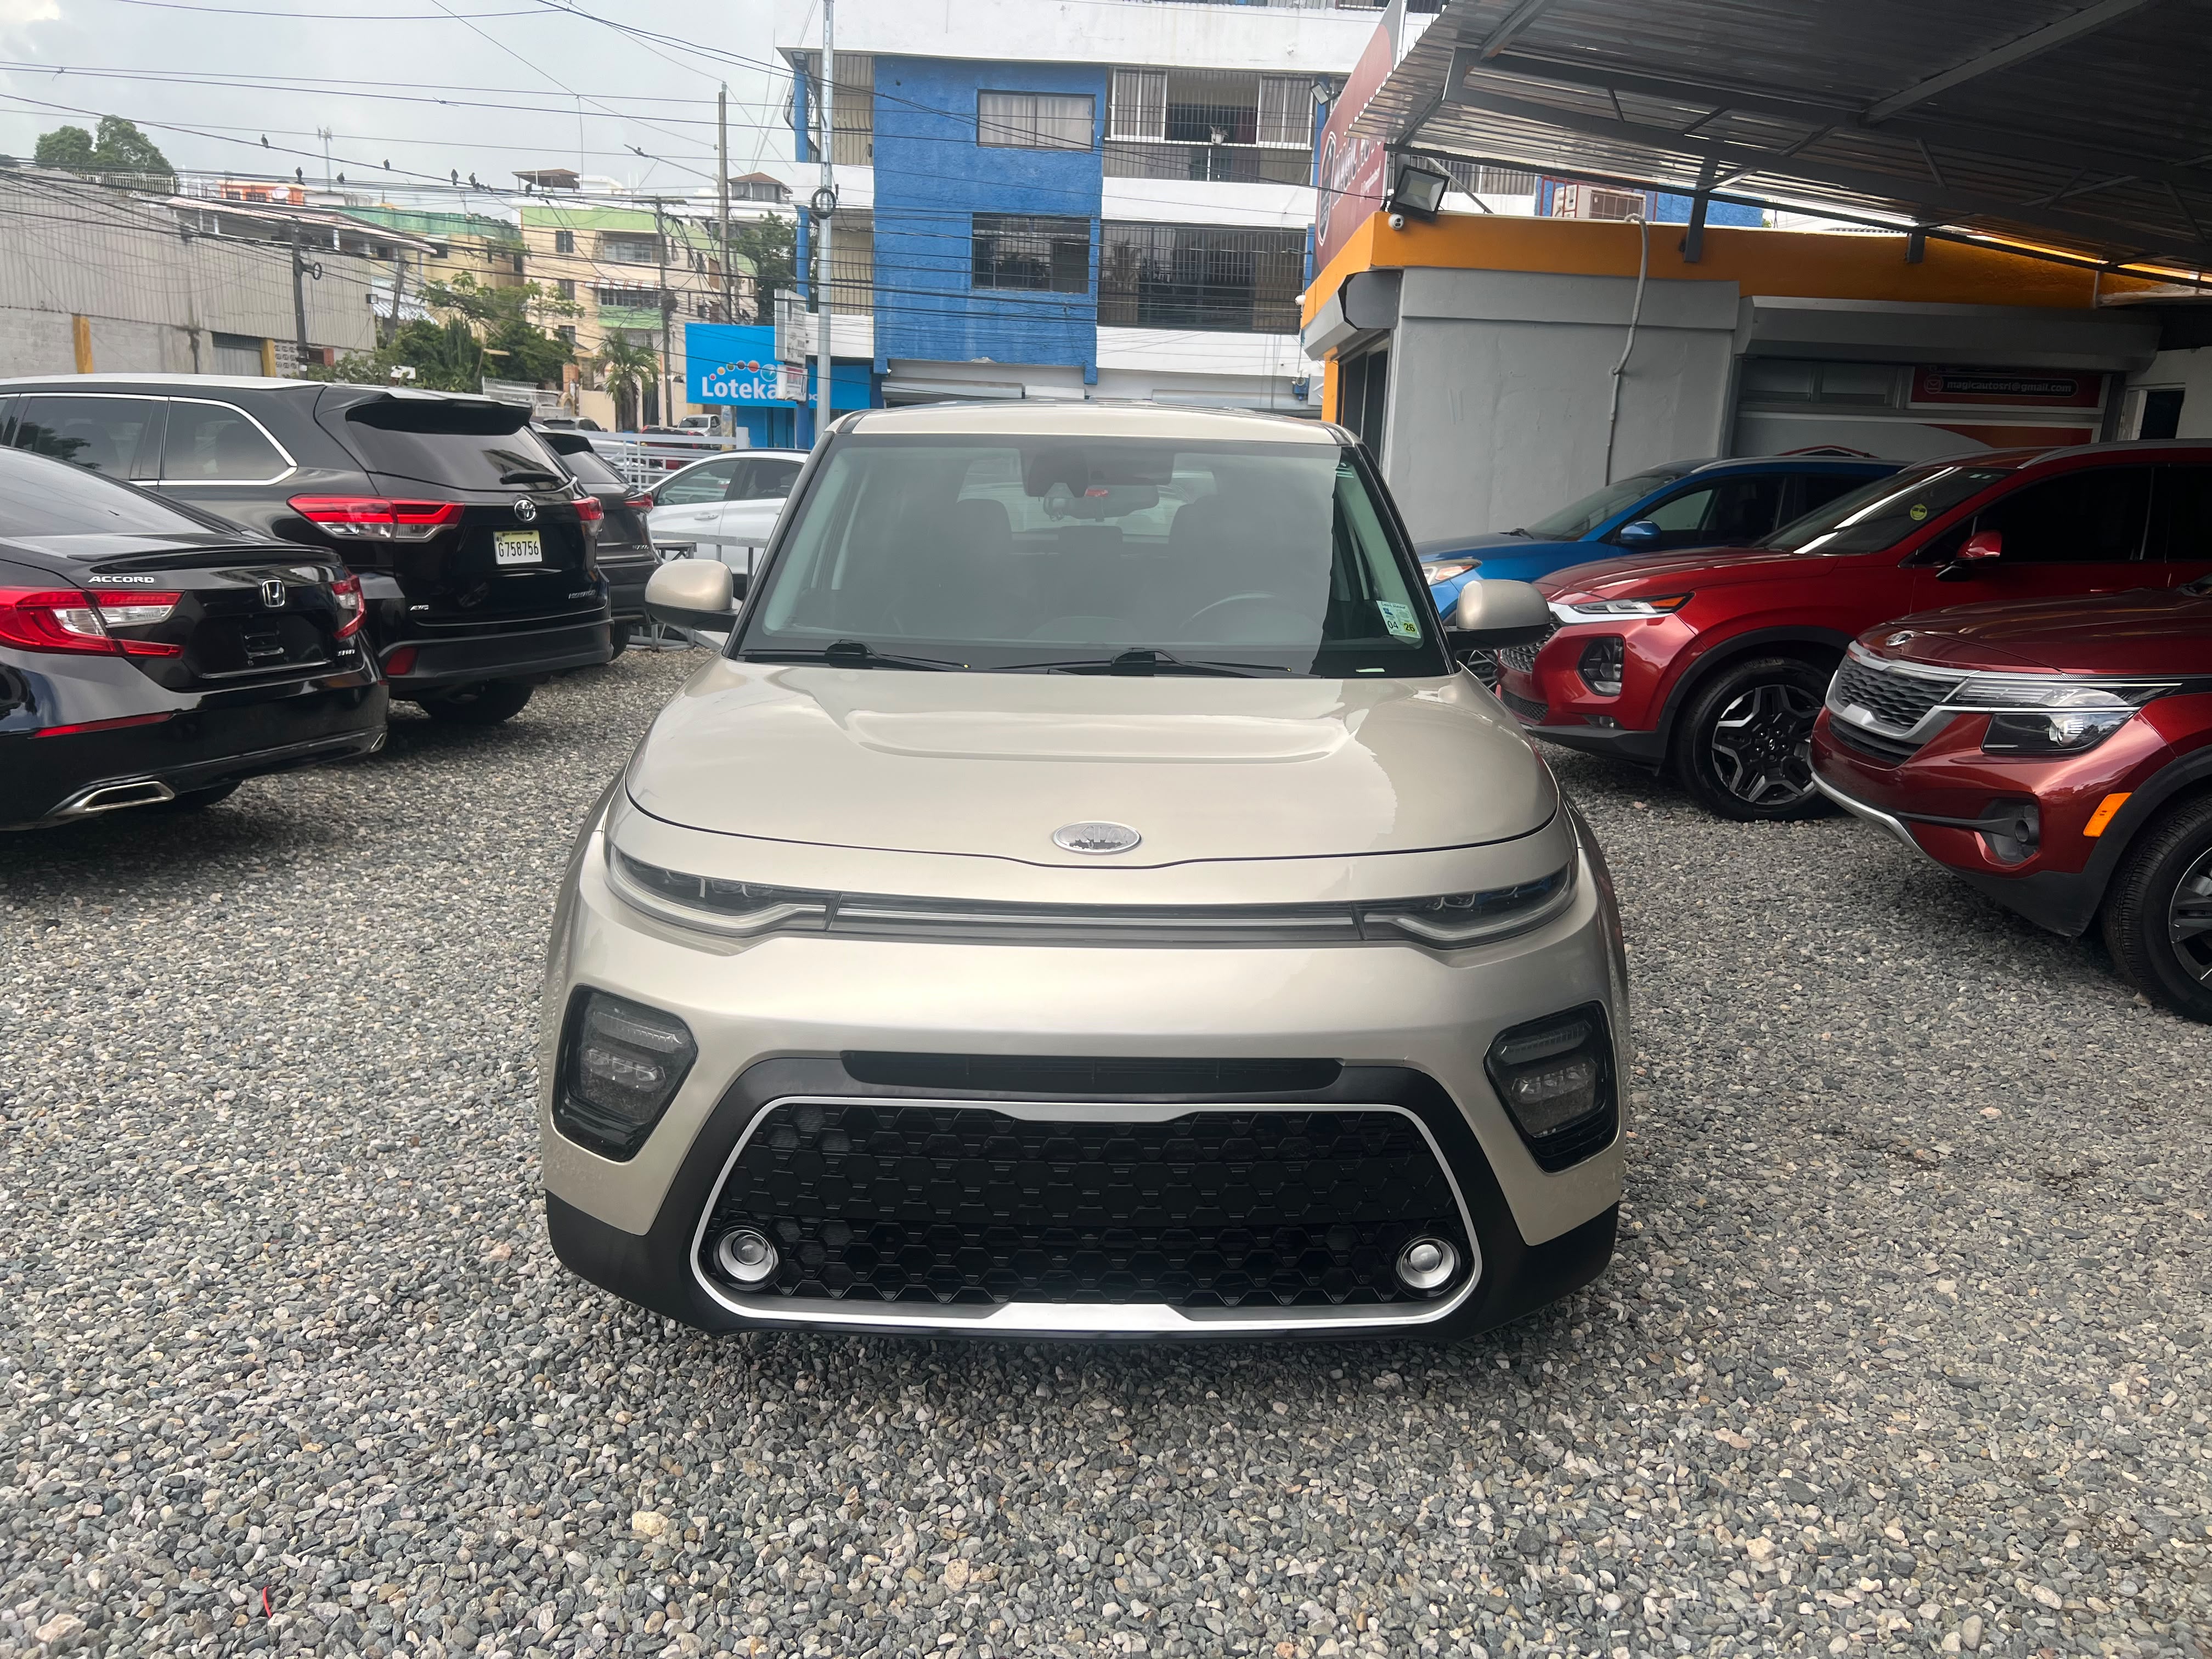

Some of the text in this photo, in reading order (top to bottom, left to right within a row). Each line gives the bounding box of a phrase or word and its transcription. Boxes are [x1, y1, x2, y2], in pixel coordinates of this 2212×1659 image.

[702, 376, 777, 399] Loteka
[498, 541, 539, 557] G758756
[1387, 620, 1415, 631] 04 26
[1076, 825, 1125, 843] KIA
